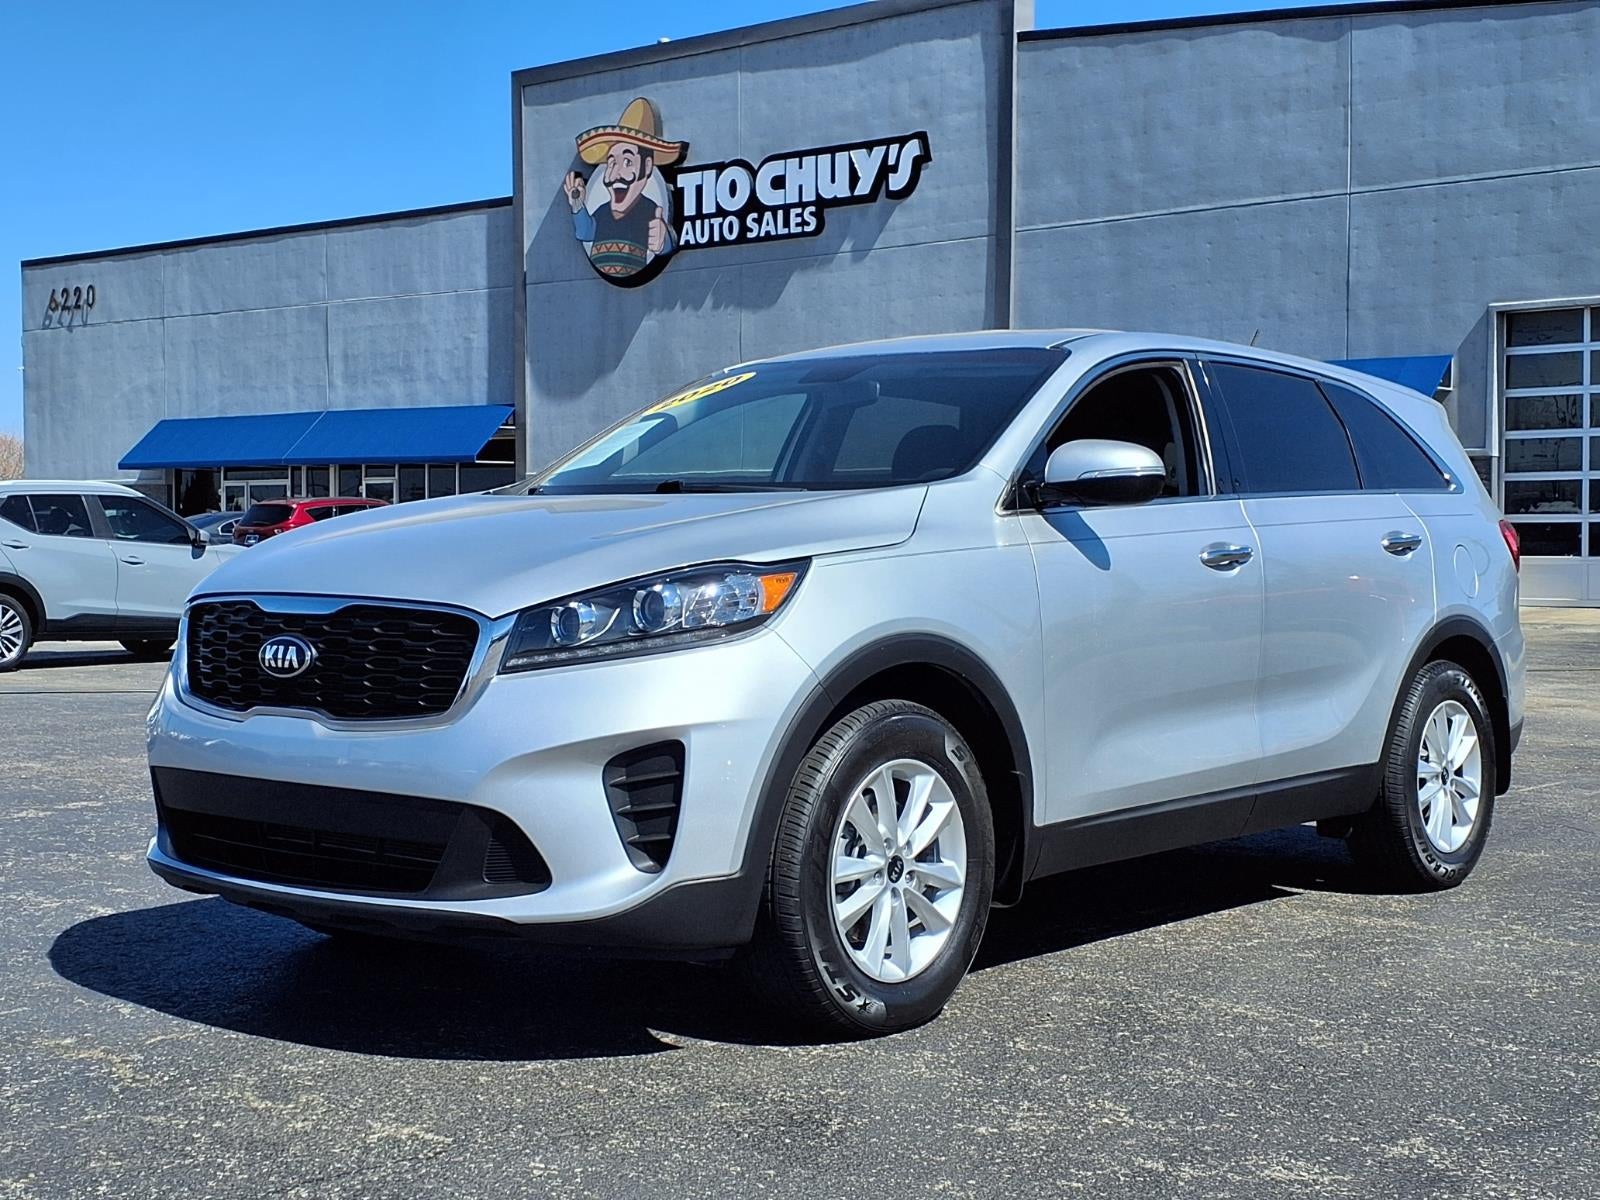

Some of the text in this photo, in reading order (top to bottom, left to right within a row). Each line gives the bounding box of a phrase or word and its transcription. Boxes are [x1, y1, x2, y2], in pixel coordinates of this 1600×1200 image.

[677, 138, 924, 217] TIO CHUY'S
[679, 205, 818, 246] AUTO SALES
[48, 284, 96, 312] 6220
[264, 644, 299, 669] KIA
